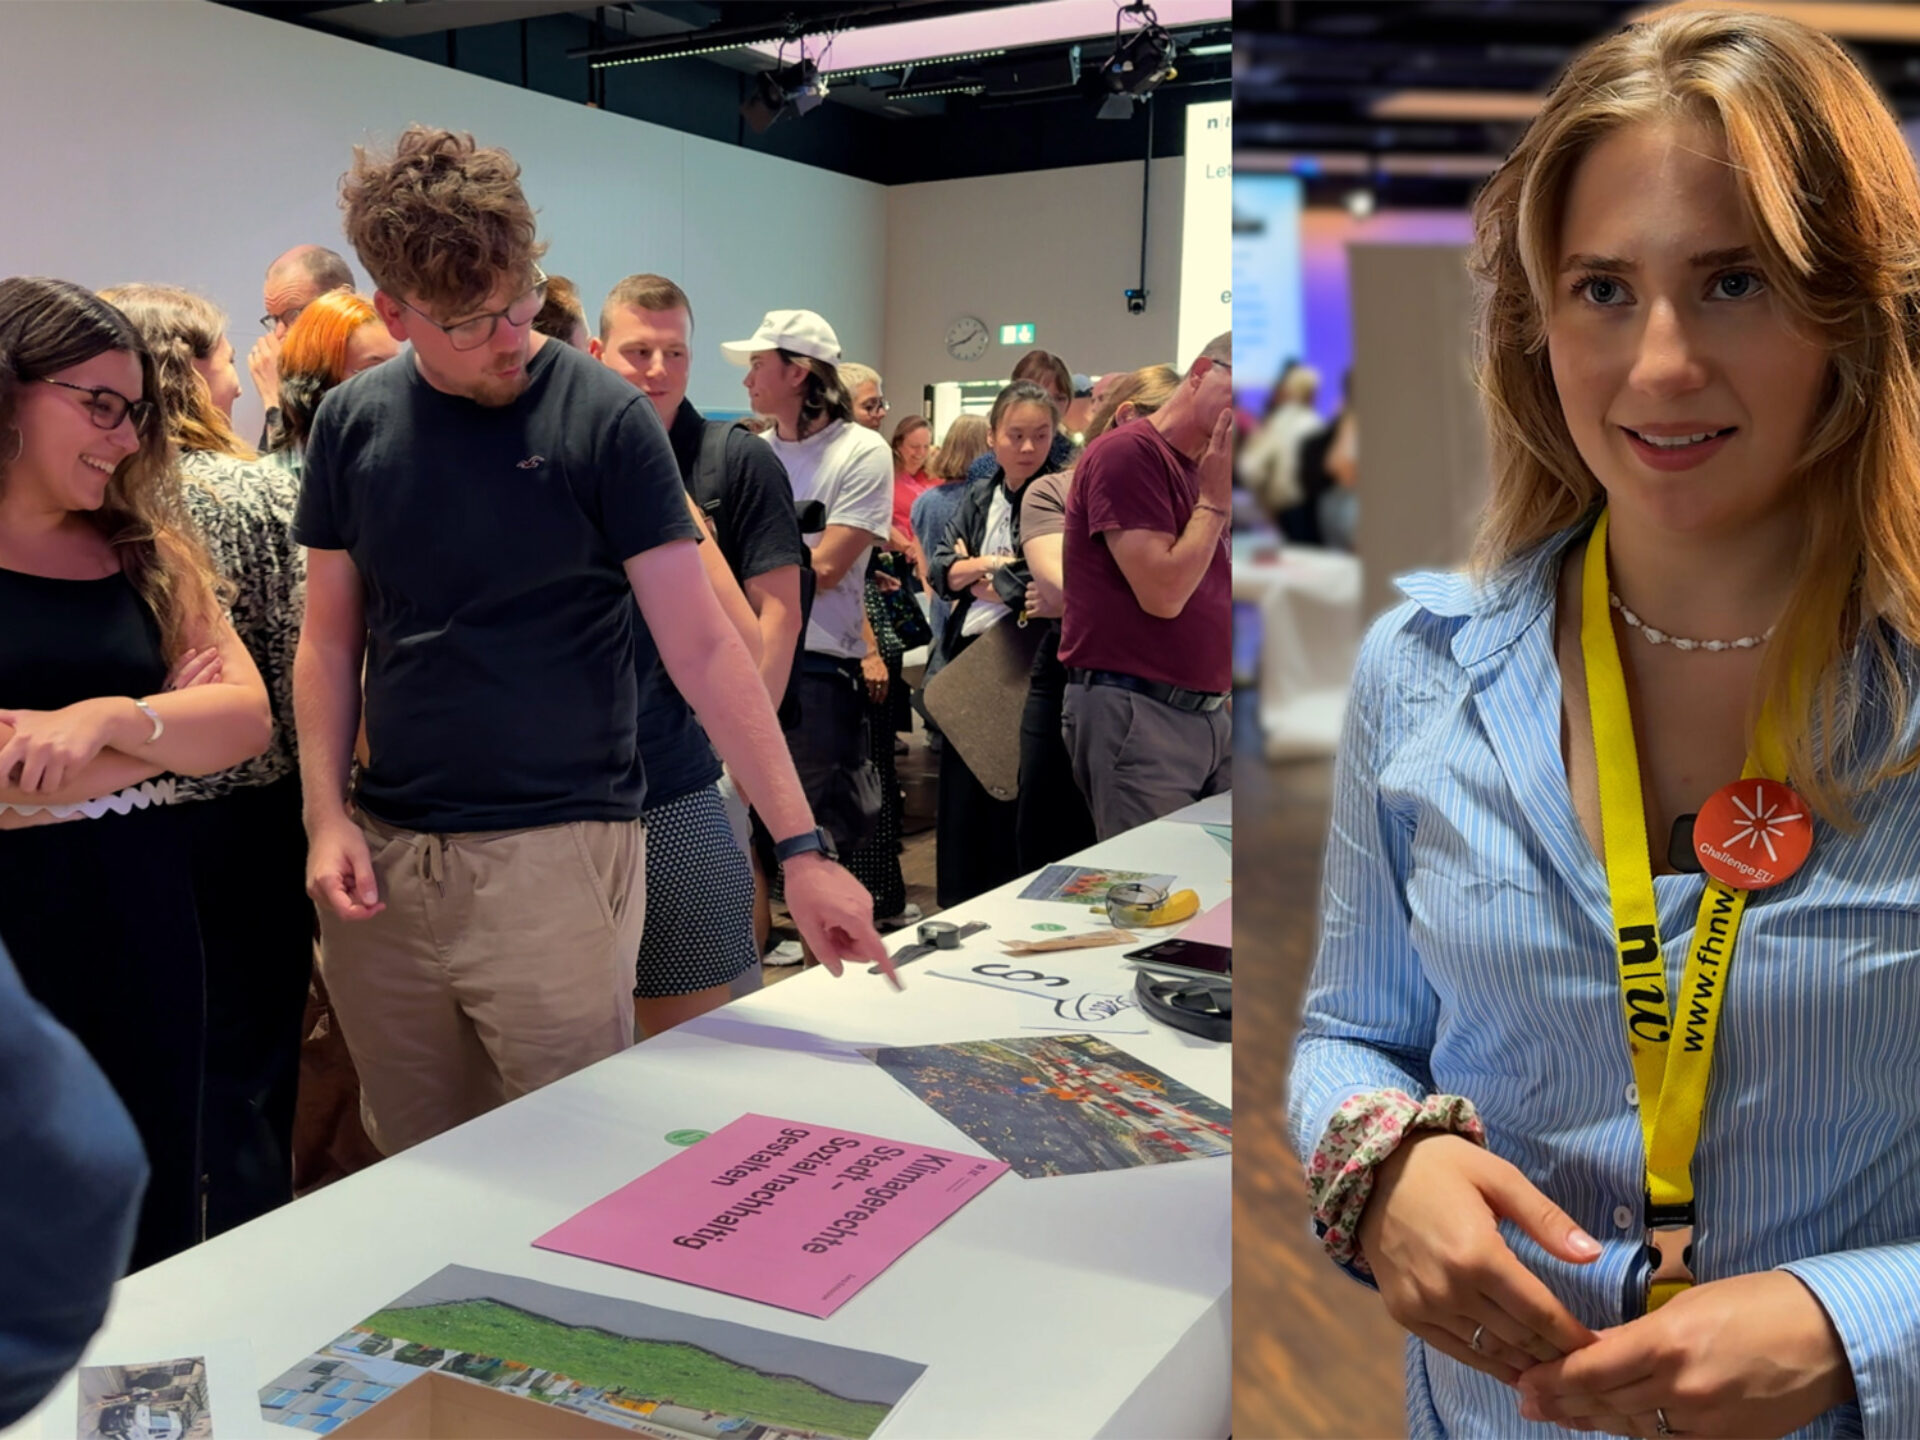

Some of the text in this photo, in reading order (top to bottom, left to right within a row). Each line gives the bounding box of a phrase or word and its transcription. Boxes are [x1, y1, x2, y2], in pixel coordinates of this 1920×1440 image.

[673, 1137, 861, 1250] Sozial nachhaltig
[711, 1127, 810, 1186] gestalten
[836, 1146, 905, 1181] Stadt
[802, 1153, 953, 1255] Klimagerechte
